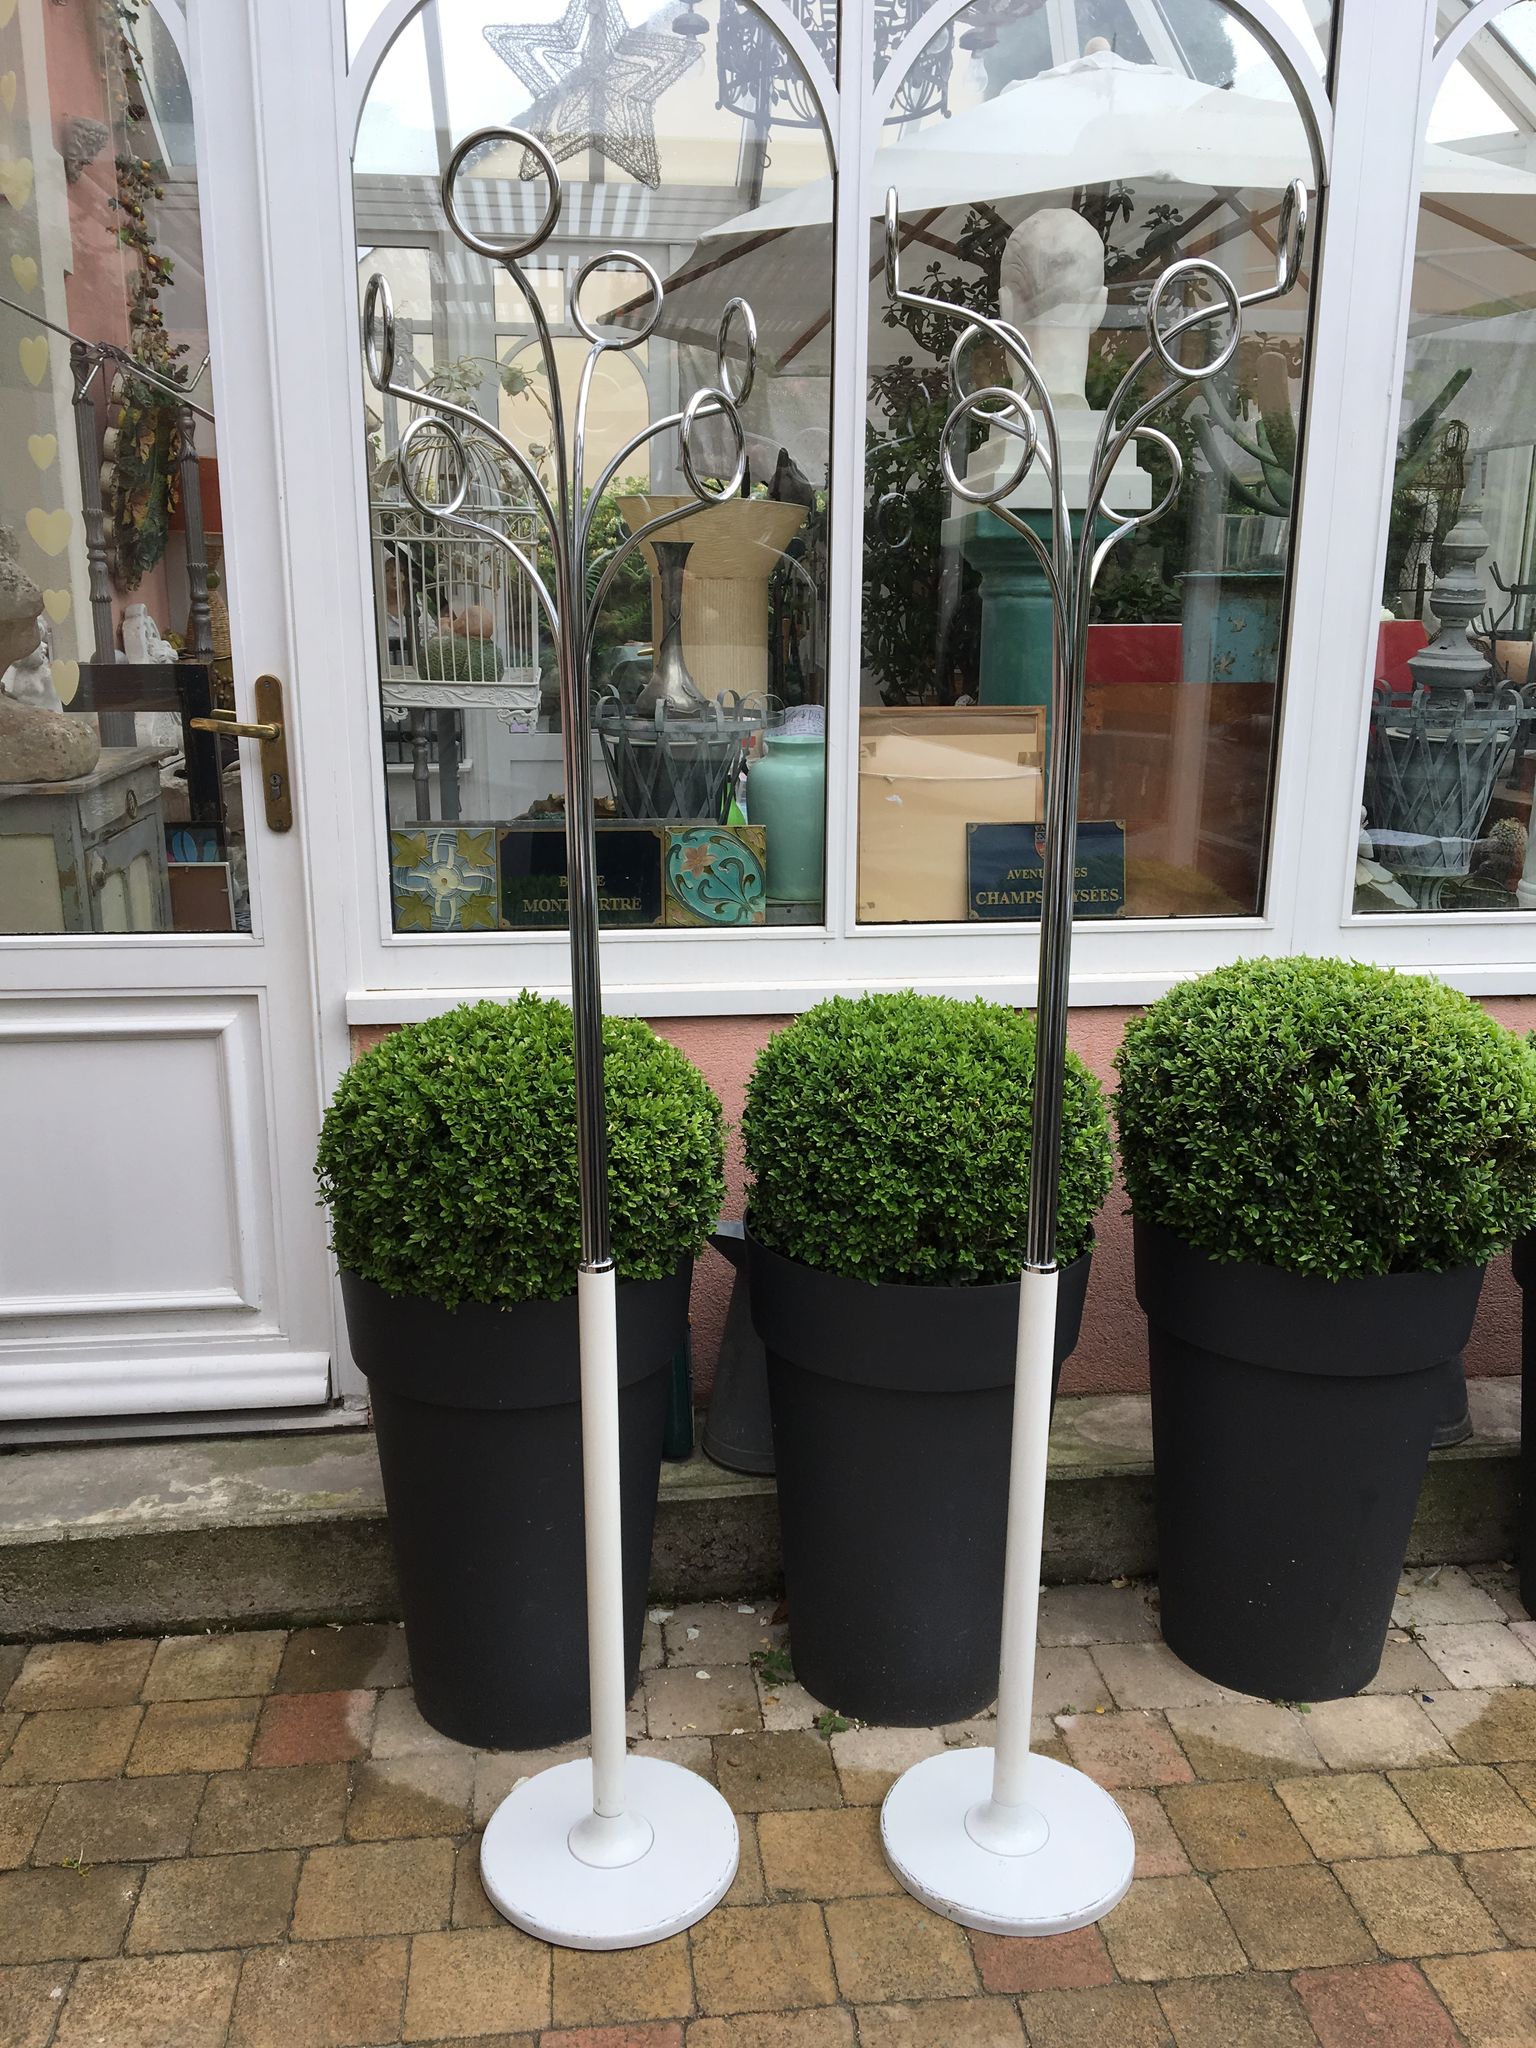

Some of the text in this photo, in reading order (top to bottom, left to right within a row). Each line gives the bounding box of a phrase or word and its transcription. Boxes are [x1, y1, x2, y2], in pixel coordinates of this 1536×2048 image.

[1007, 867, 1088, 880] AVENU ES
[522, 897, 642, 913] MONTRTRE
